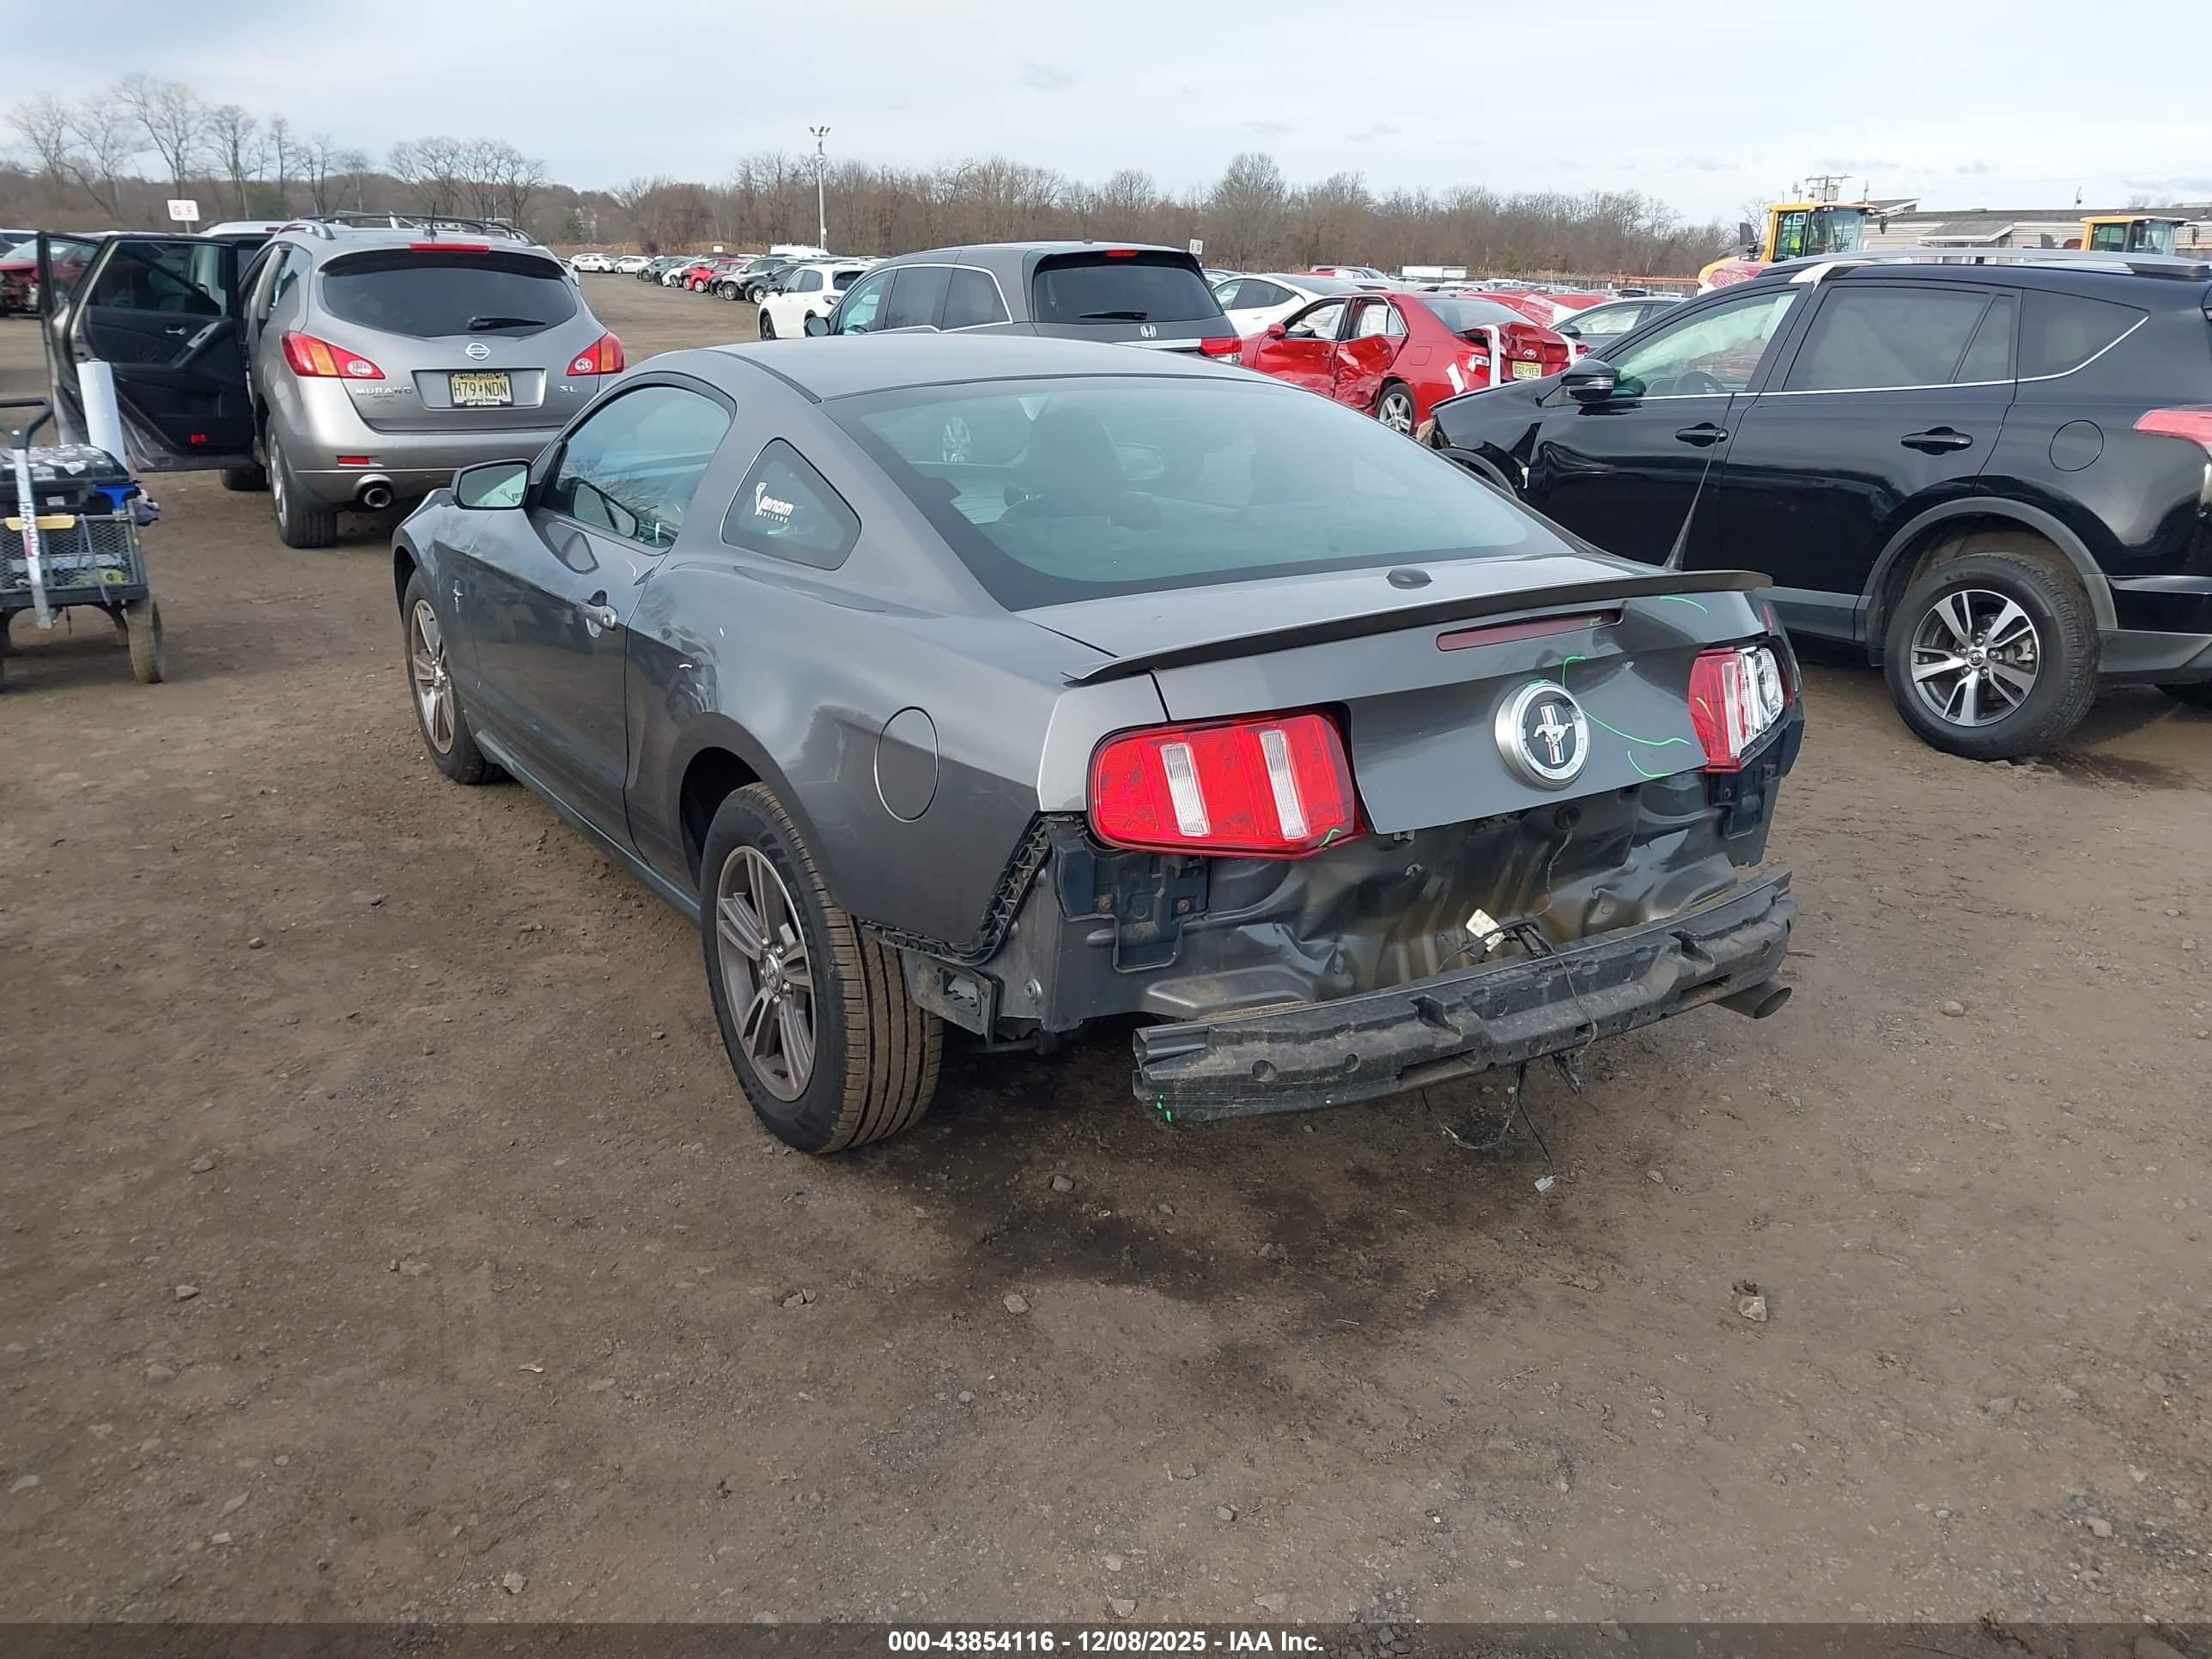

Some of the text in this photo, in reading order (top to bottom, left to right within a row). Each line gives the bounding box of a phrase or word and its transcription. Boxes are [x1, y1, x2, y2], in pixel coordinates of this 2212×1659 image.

[356, 386, 413, 395] MURANO
[453, 381, 477, 397] H79
[559, 385, 577, 393] SL
